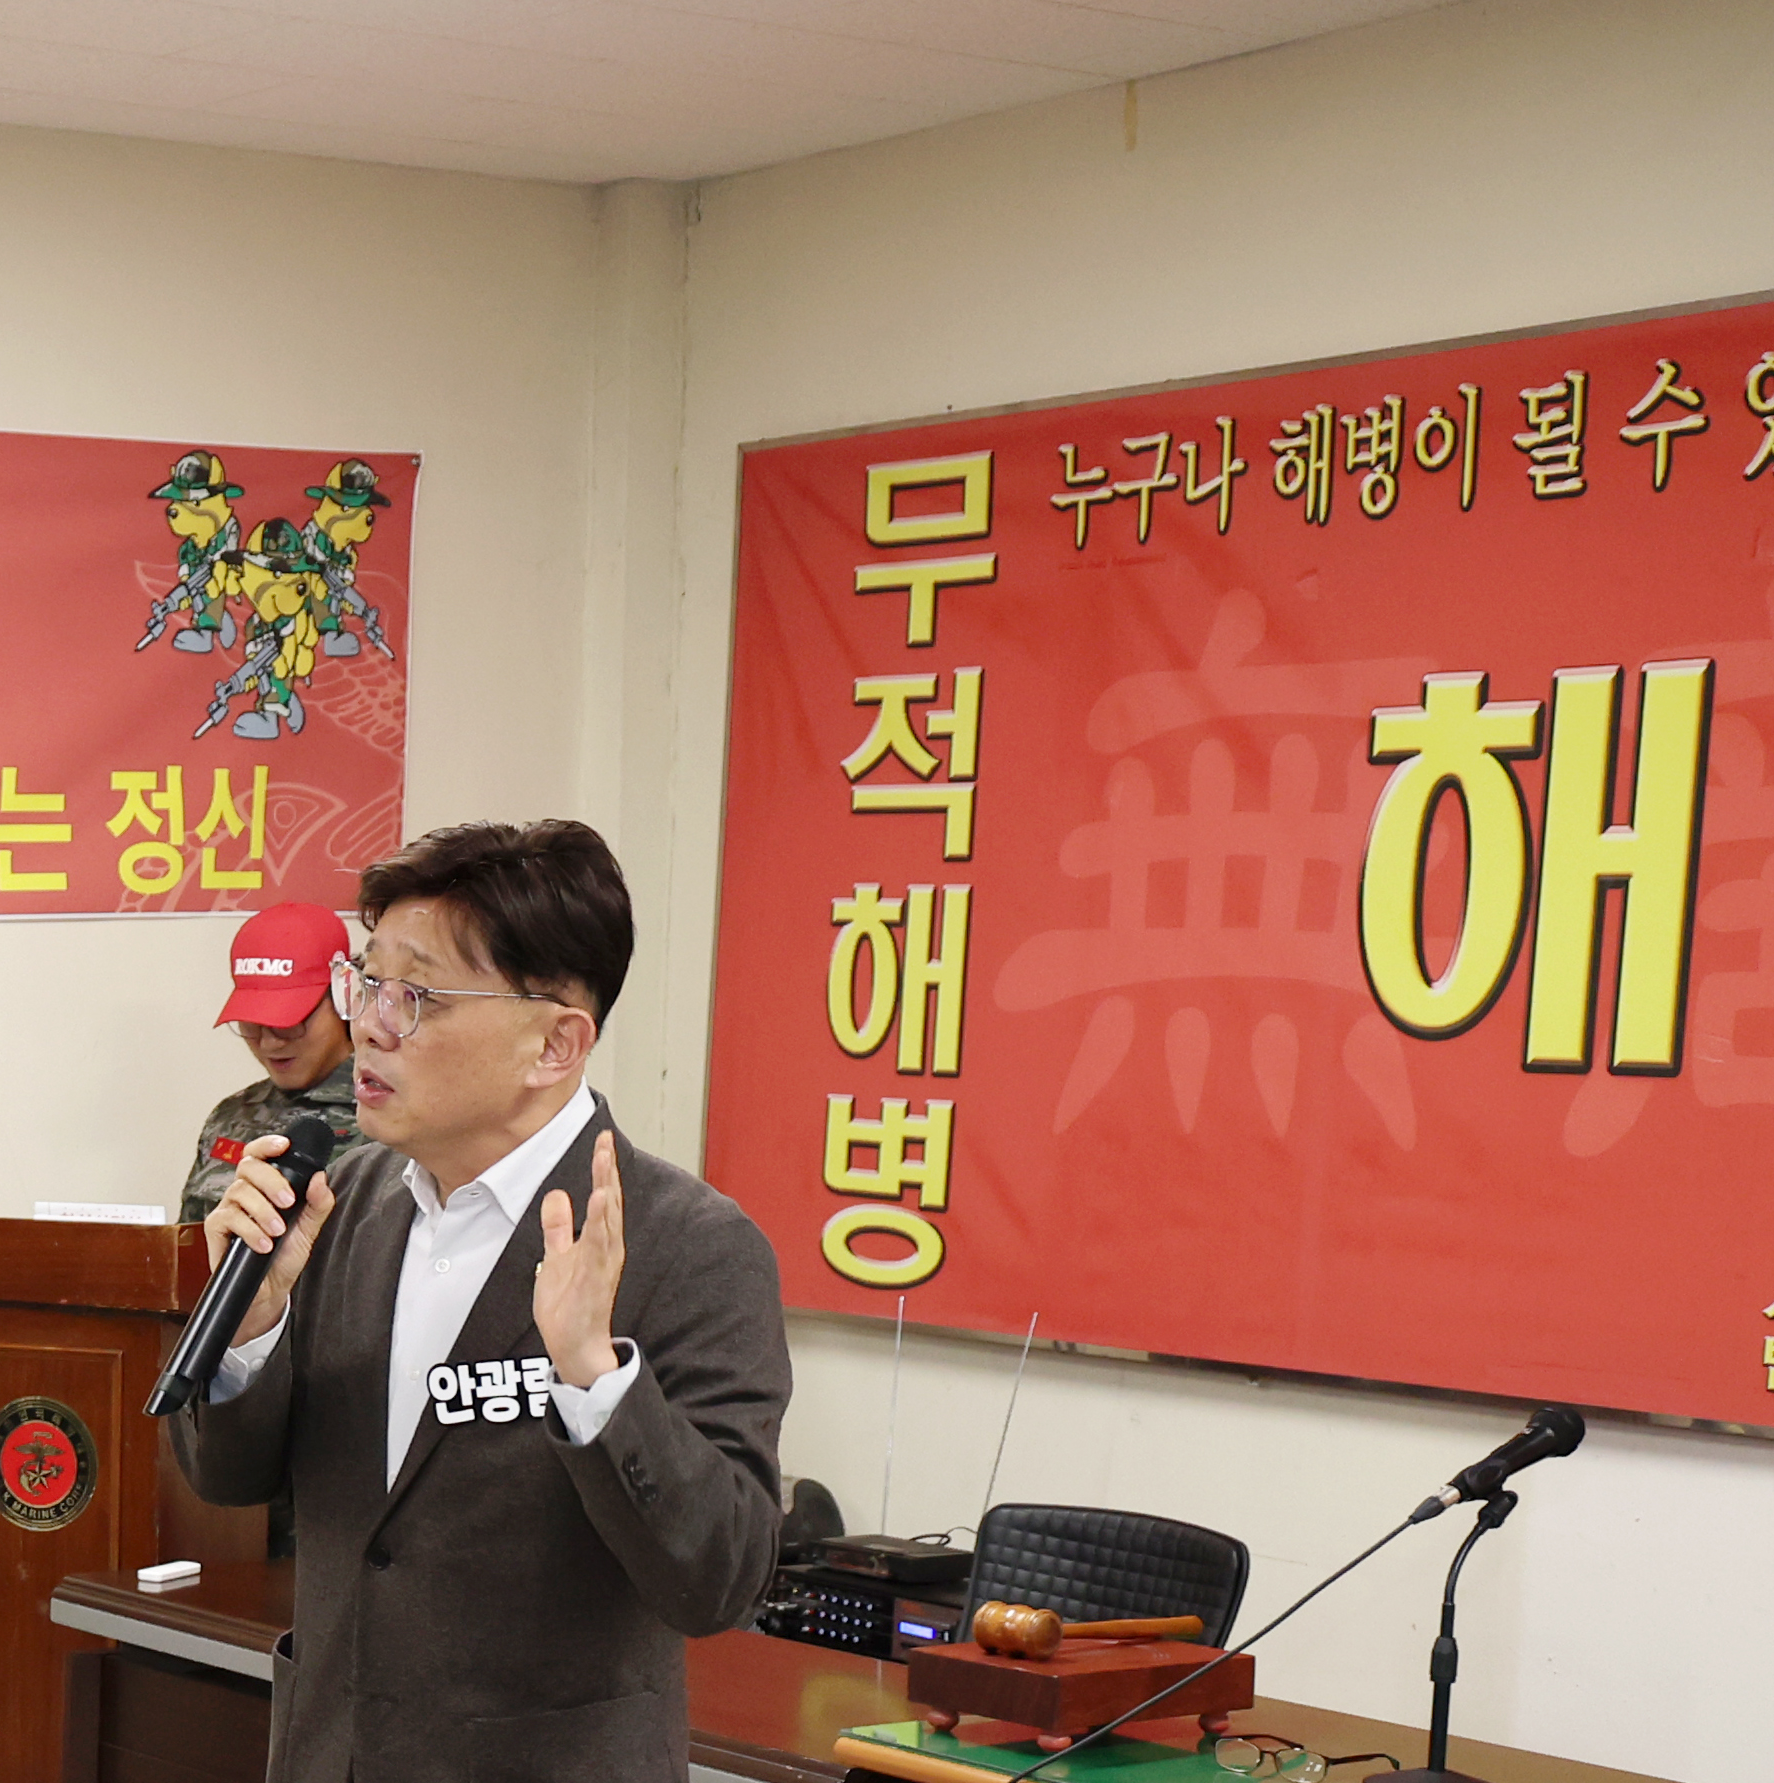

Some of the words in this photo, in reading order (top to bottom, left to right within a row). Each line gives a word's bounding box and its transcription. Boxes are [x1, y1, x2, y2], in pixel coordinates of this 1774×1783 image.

[1052, 417, 1247, 549] 누구나
[1270, 385, 1481, 525] 해병이
[1512, 370, 1588, 498] 될
[1620, 358, 1710, 489] 수
[107, 766, 268, 894] 정신
[820, 450, 998, 1288] 무적해병
[1360, 658, 1712, 1076] 해
[12, 1500, 58, 1519] MARINE
